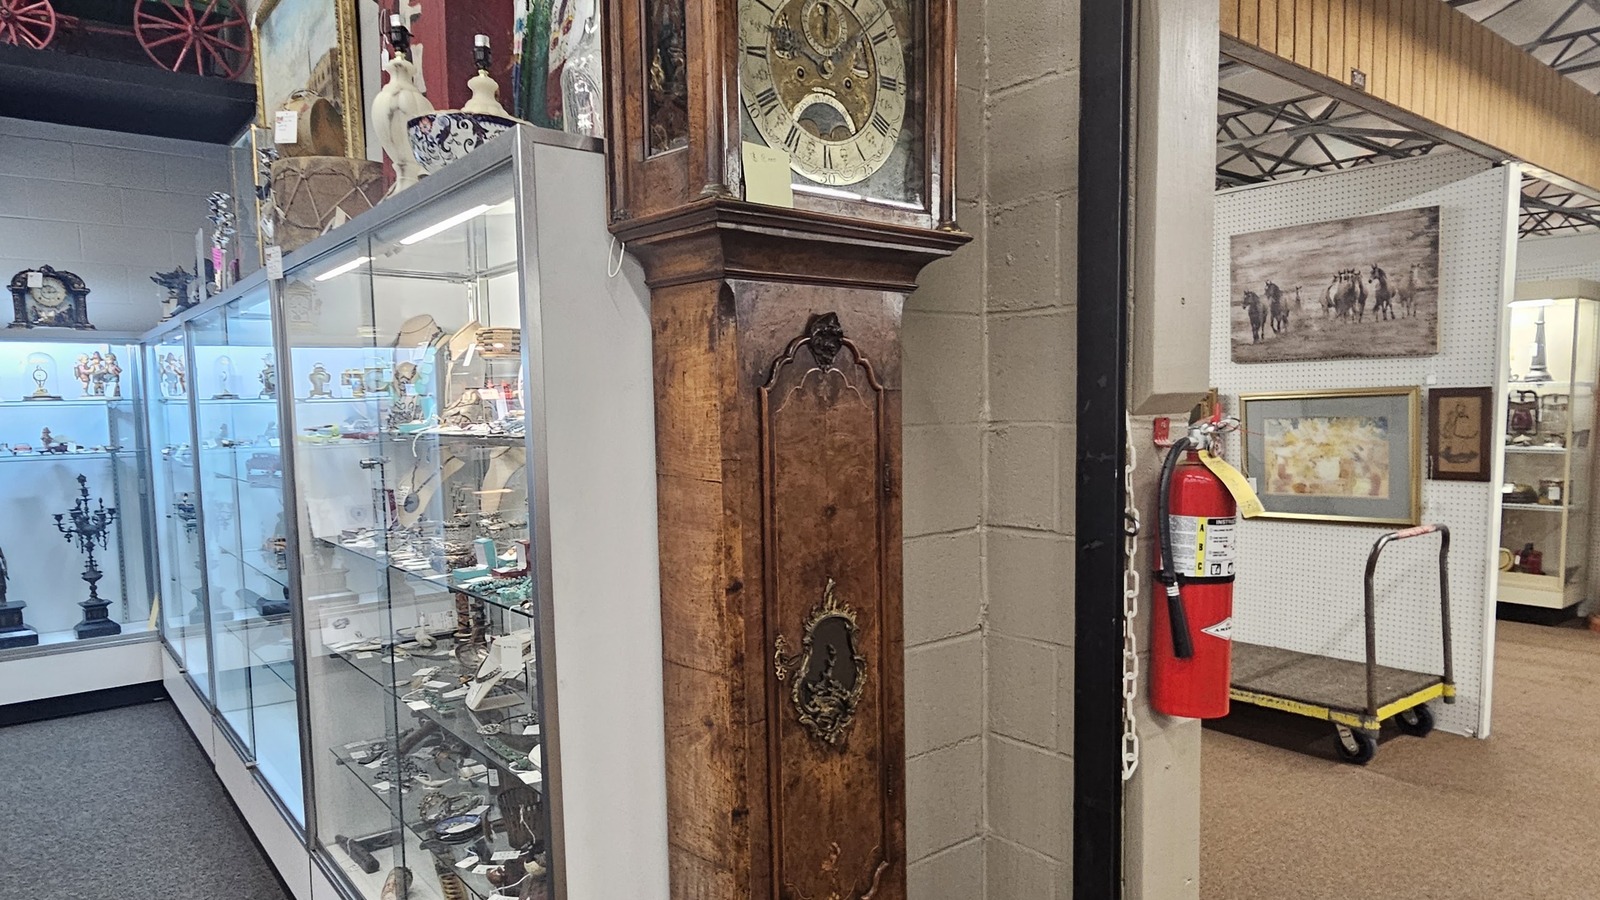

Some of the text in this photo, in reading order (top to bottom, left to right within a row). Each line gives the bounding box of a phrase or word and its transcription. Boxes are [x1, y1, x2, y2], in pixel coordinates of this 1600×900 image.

[1199, 523, 1204, 532] A
[1198, 543, 1203, 551] B
[1197, 562, 1203, 570] C
